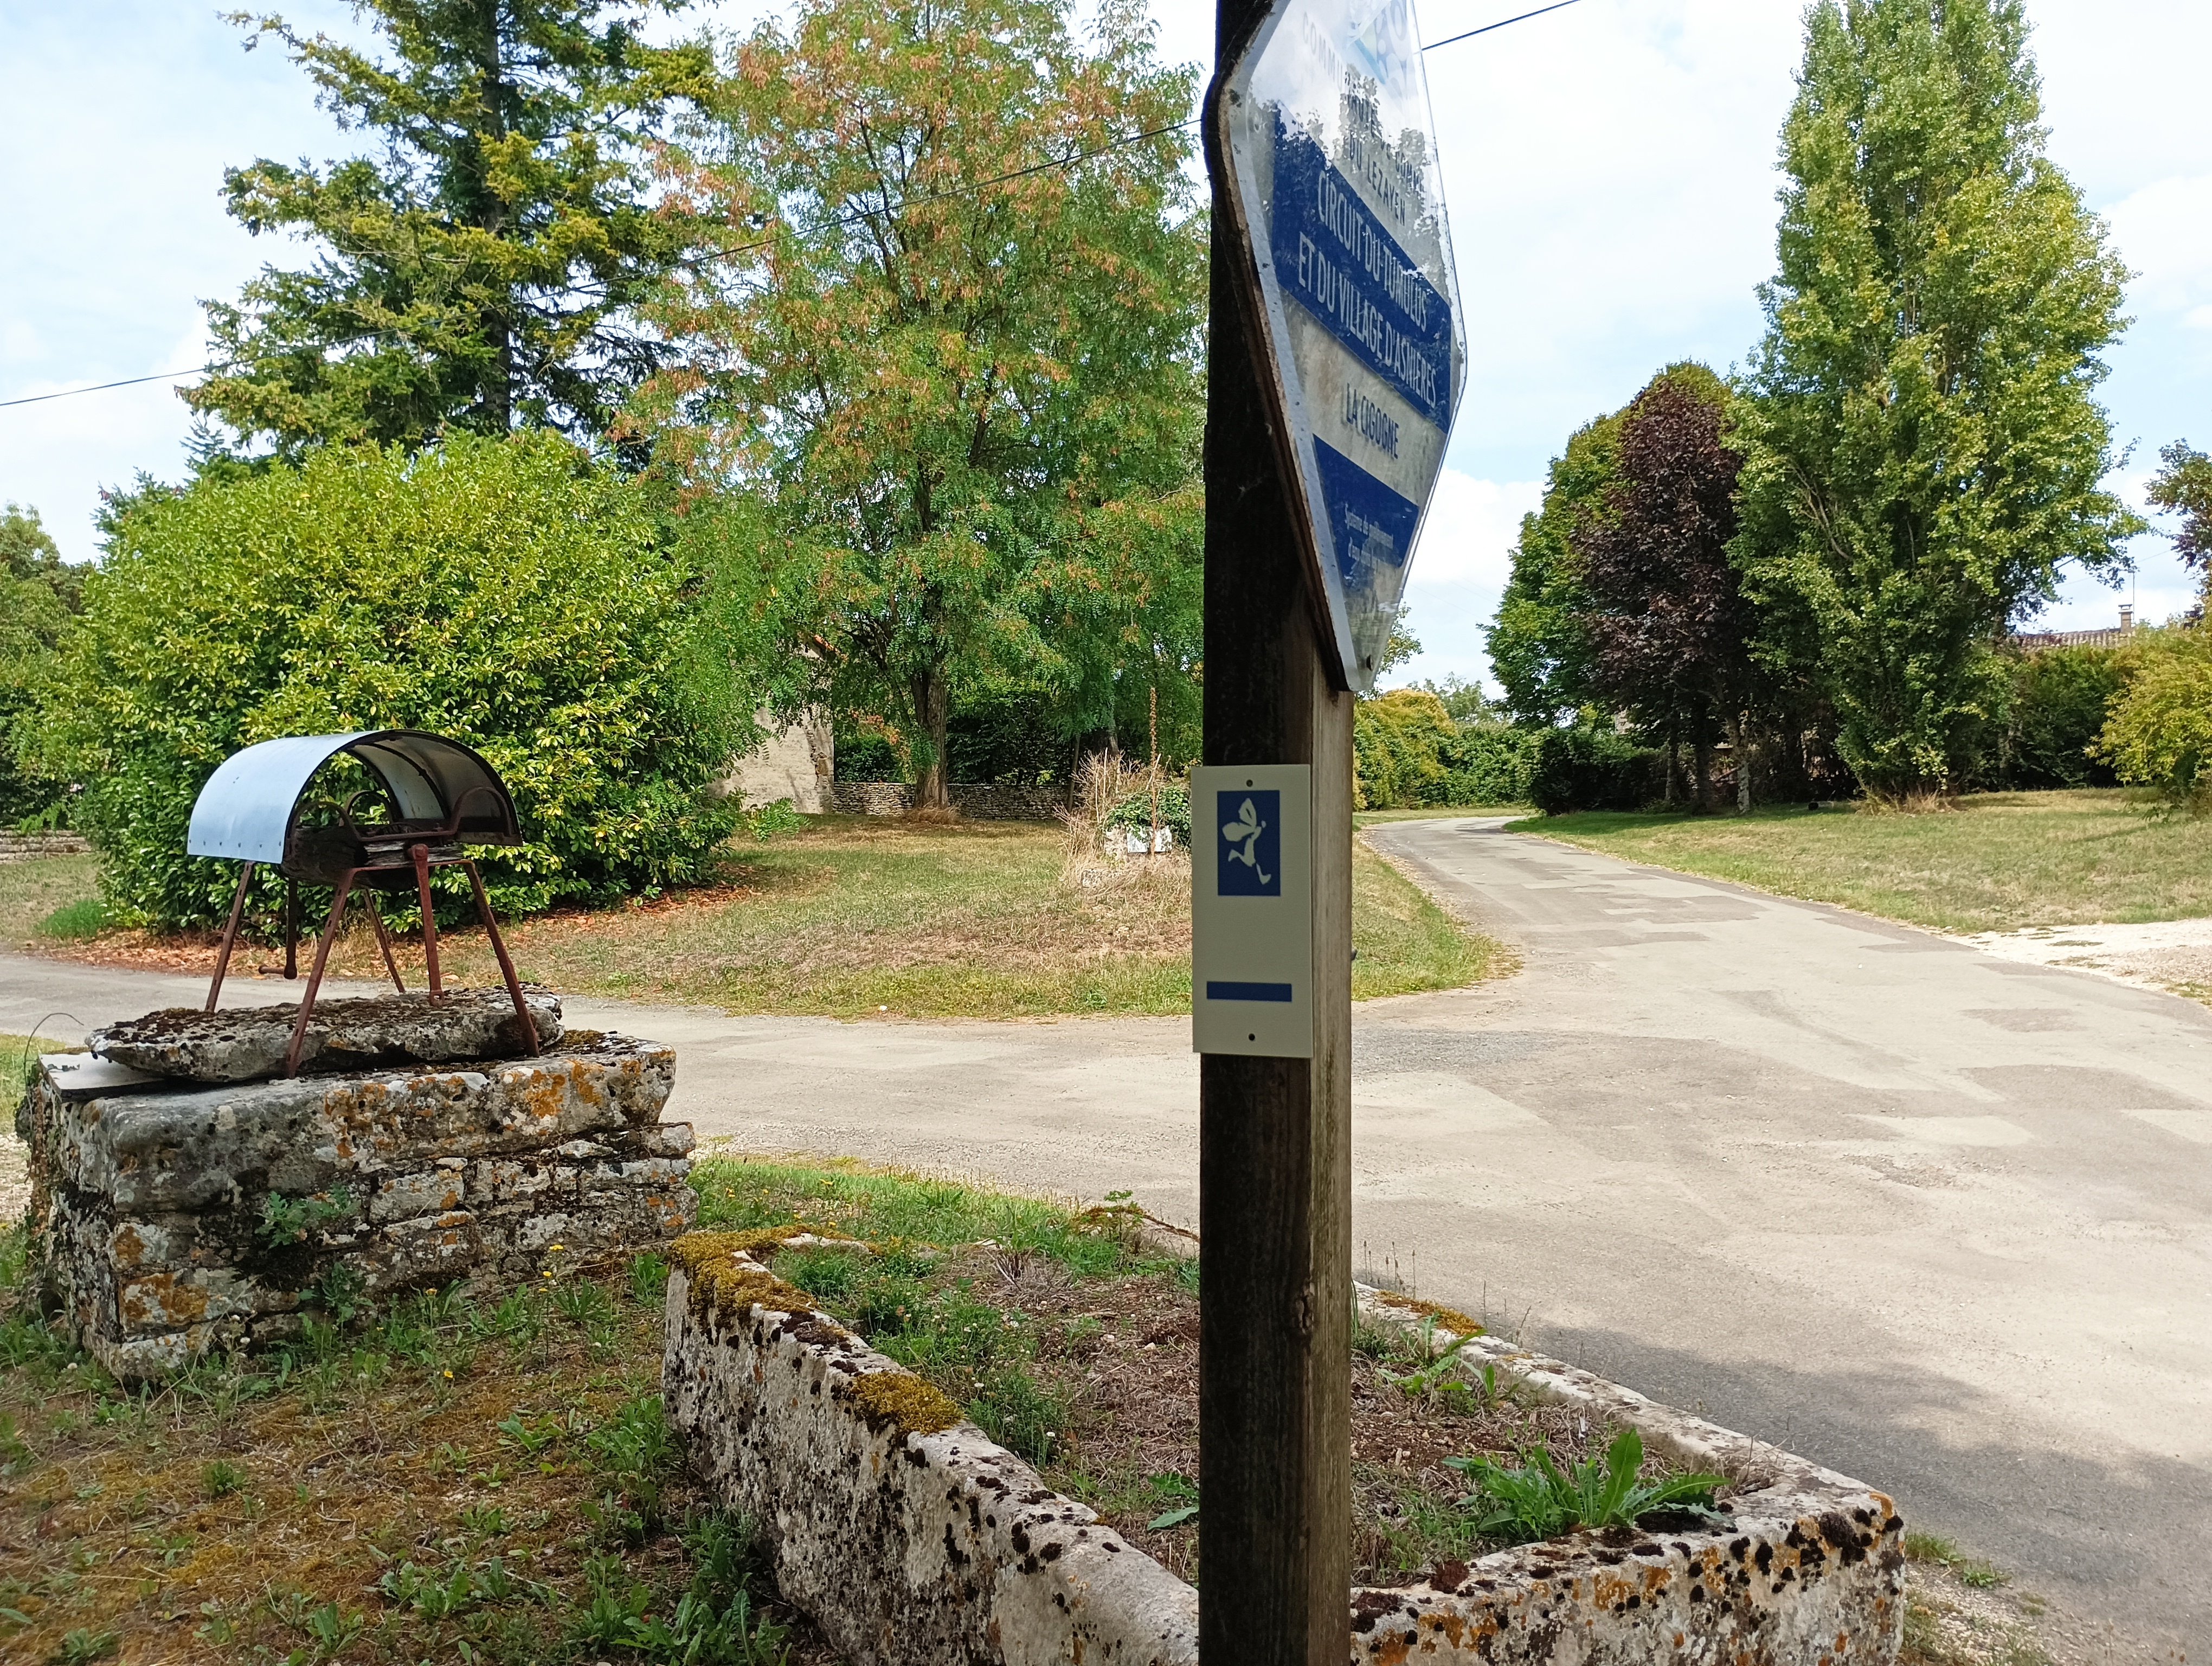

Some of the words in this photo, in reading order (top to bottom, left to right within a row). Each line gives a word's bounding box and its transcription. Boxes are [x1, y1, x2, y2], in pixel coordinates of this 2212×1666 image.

[1319, 169, 1364, 261] CIRCUIT
[1365, 223, 1380, 281] DU
[1383, 244, 1427, 332] TUMULUS
[1367, 154, 1405, 227] LEZAYEN
[1298, 231, 1316, 293] ET
[1317, 251, 1336, 313] DU
[1339, 272, 1384, 360] VILLAGE
[1385, 321, 1436, 409] D'ASNIERES
[1346, 382, 1358, 430] LA
[1361, 395, 1399, 460] CIGOGNE
